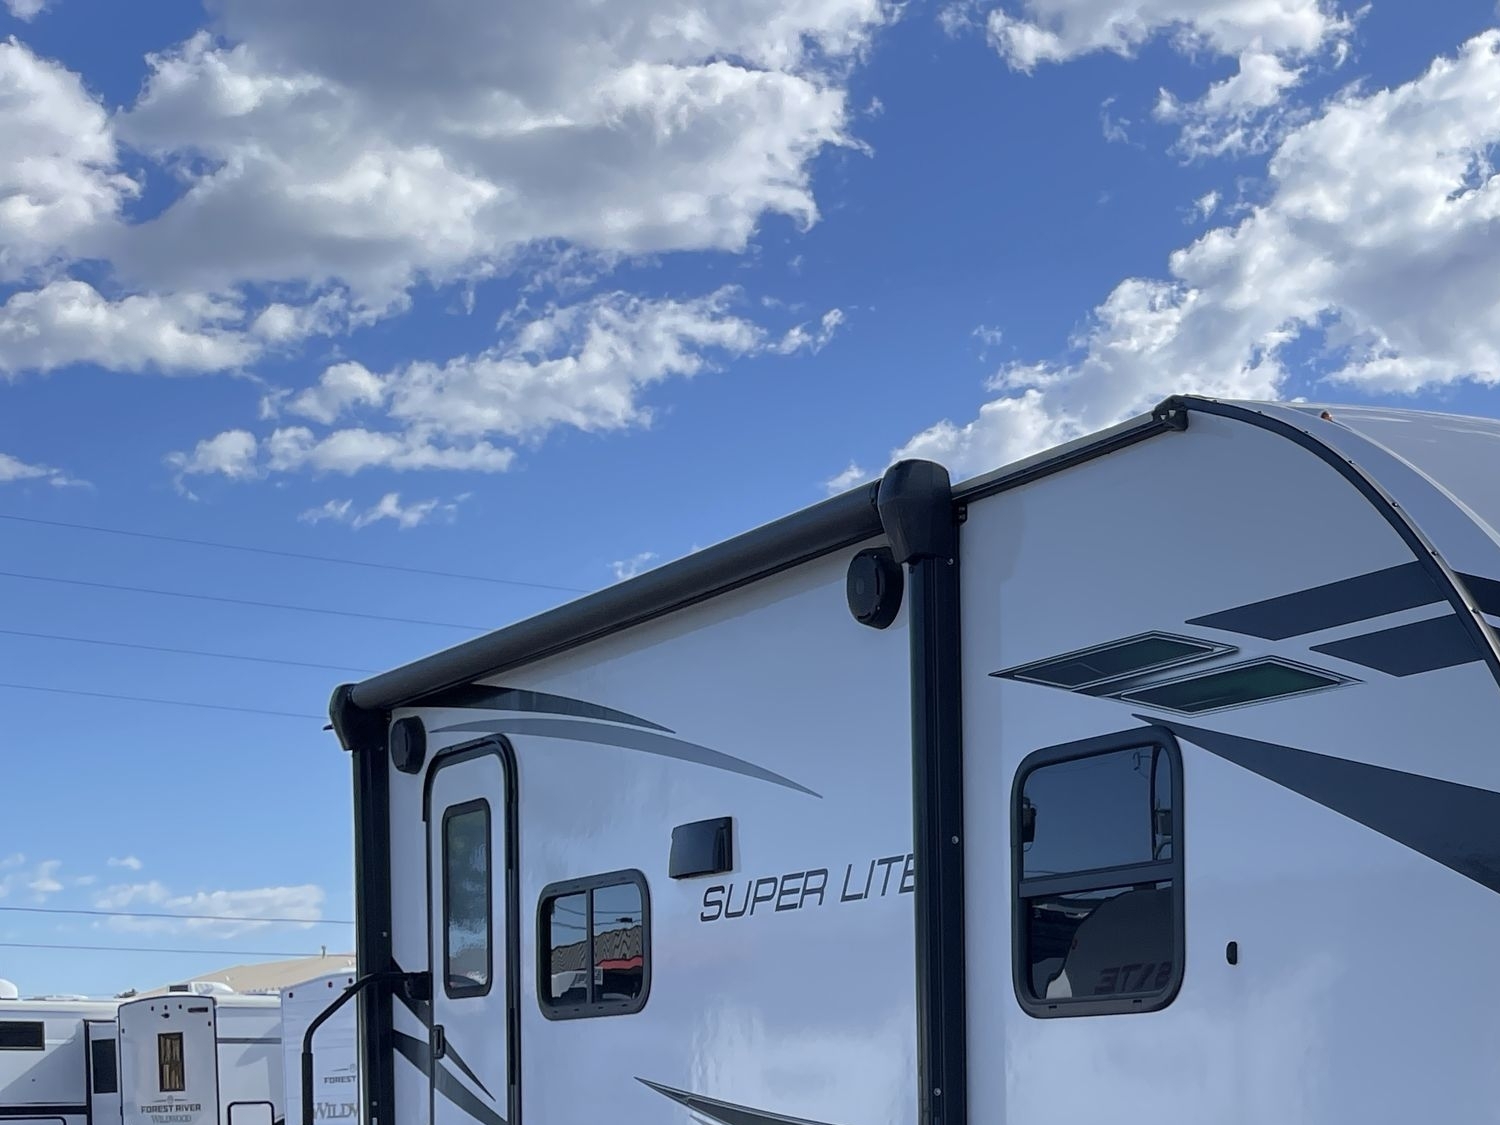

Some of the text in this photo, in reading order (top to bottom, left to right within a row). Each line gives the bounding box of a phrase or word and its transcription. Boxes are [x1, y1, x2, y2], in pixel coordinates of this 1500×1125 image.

[700, 853, 914, 922] SUPER LITE
[324, 1075, 357, 1084] FOREST
[141, 1103, 201, 1114] FOREST RIVER
